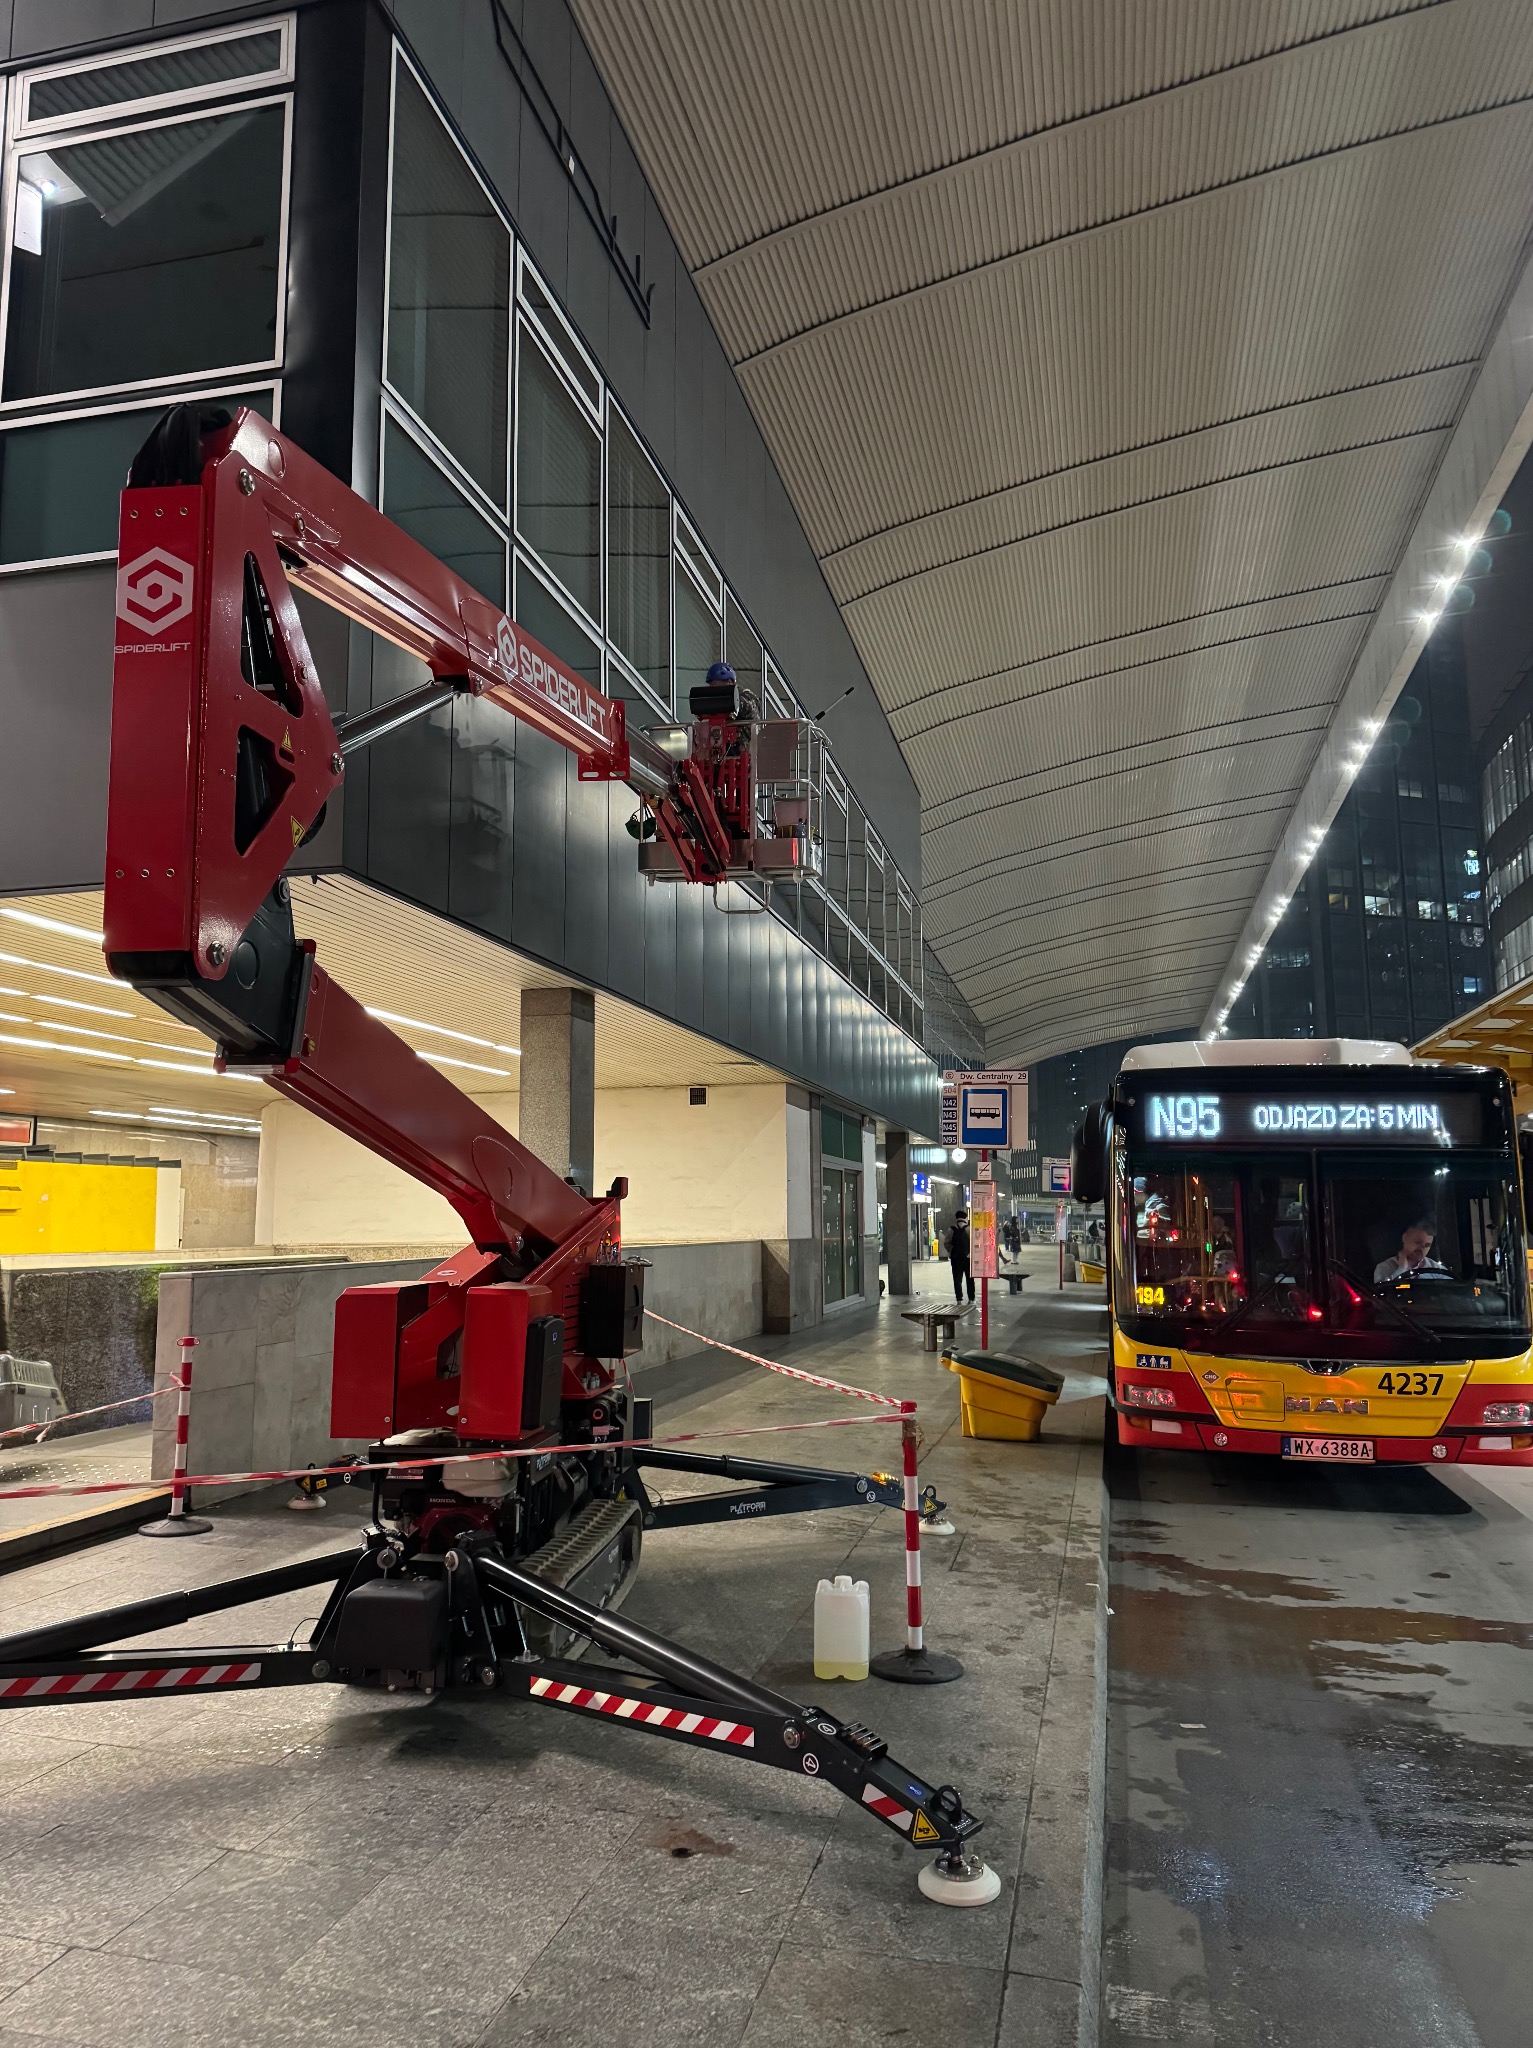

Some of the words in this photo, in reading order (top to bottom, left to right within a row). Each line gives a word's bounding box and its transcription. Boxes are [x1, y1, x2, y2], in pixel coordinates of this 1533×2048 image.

[115, 642, 190, 654] SPIDERLIFT
[519, 643, 606, 734] SPIDERLIFT
[976, 1072, 1014, 1081] Centralny
[943, 1099, 957, 1107] N42
[943, 1111, 957, 1119] N43
[1152, 1096, 1221, 1137] N95
[1255, 1105, 1337, 1129] ODJAZD
[1378, 1105, 1394, 1129] 5
[1398, 1105, 1438, 1129] MIN
[943, 1136, 957, 1144] N95
[1136, 1286, 1164, 1305] 194
[1377, 1372, 1444, 1396] 4237
[1284, 1396, 1369, 1415] MAN
[1294, 1440, 1314, 1455] WX
[1320, 1441, 1370, 1458] 6388A
